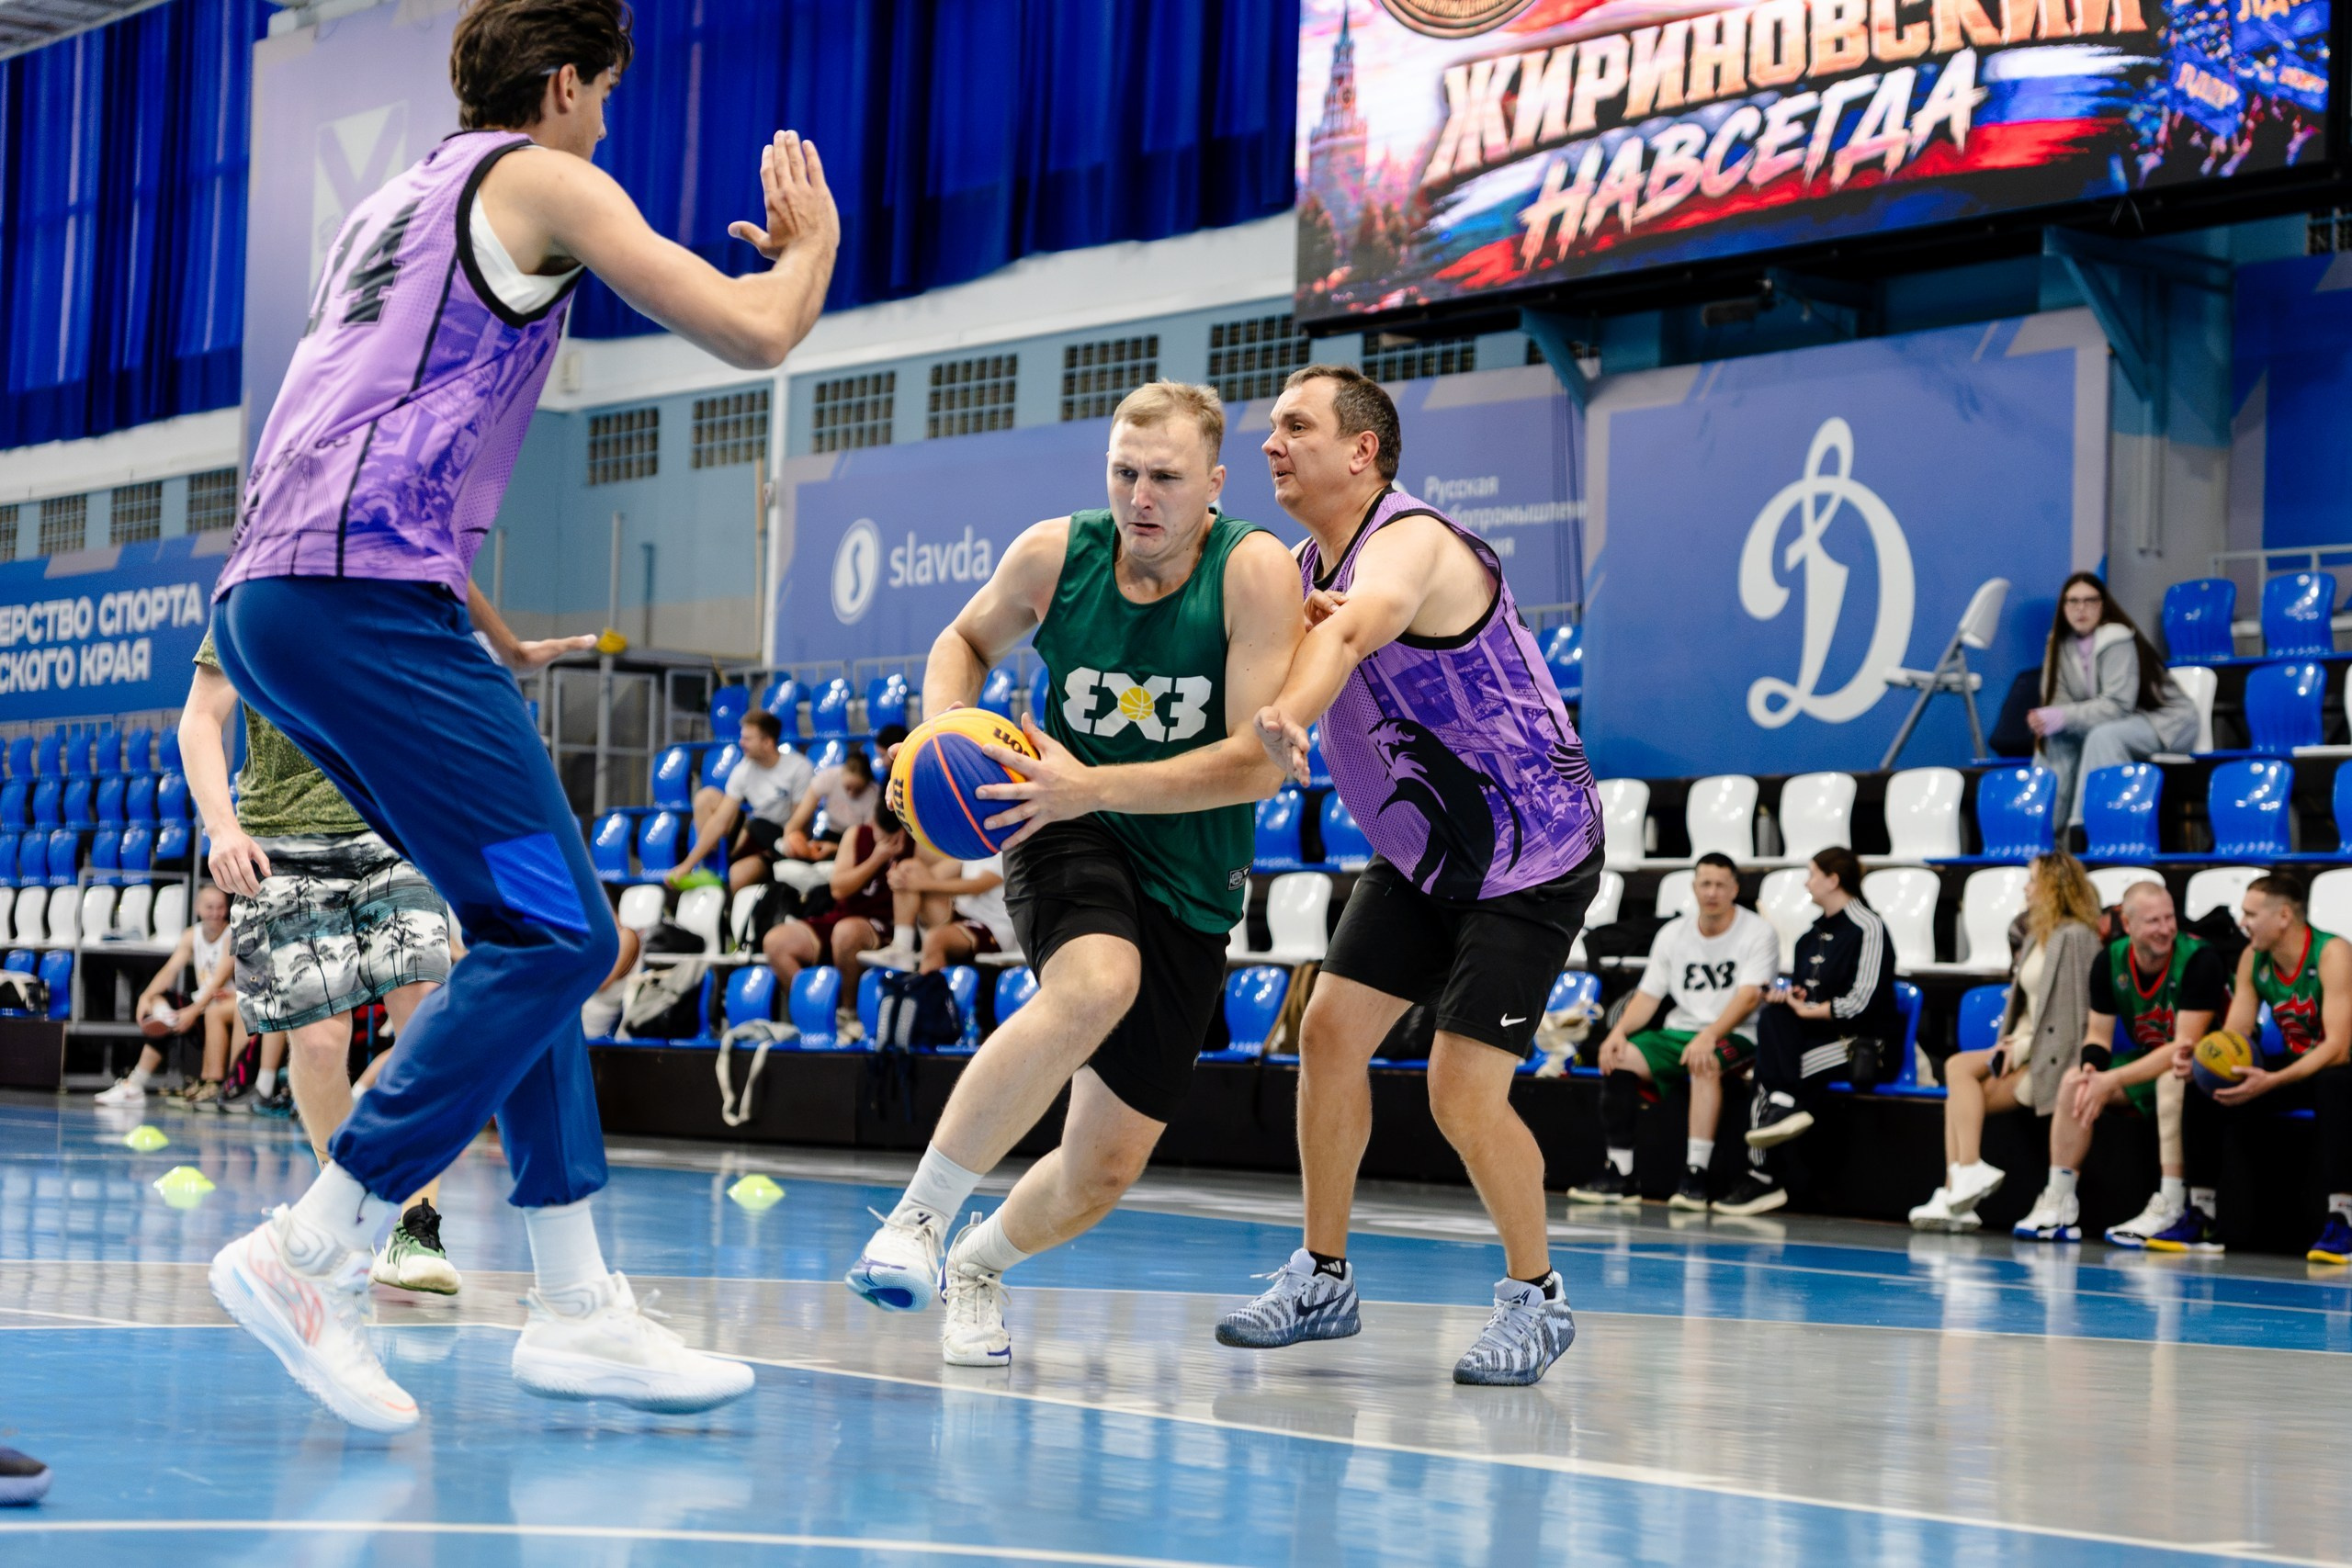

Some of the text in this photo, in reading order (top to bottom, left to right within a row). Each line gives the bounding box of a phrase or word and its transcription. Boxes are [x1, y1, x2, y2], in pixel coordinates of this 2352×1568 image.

[1519, 48, 1986, 269] НАВСЕГДА
[1424, 475, 1499, 506] Русская
[888, 525, 994, 589] slavda
[98, 581, 205, 636] СПОРТА
[79, 637, 153, 687] КРАЯ
